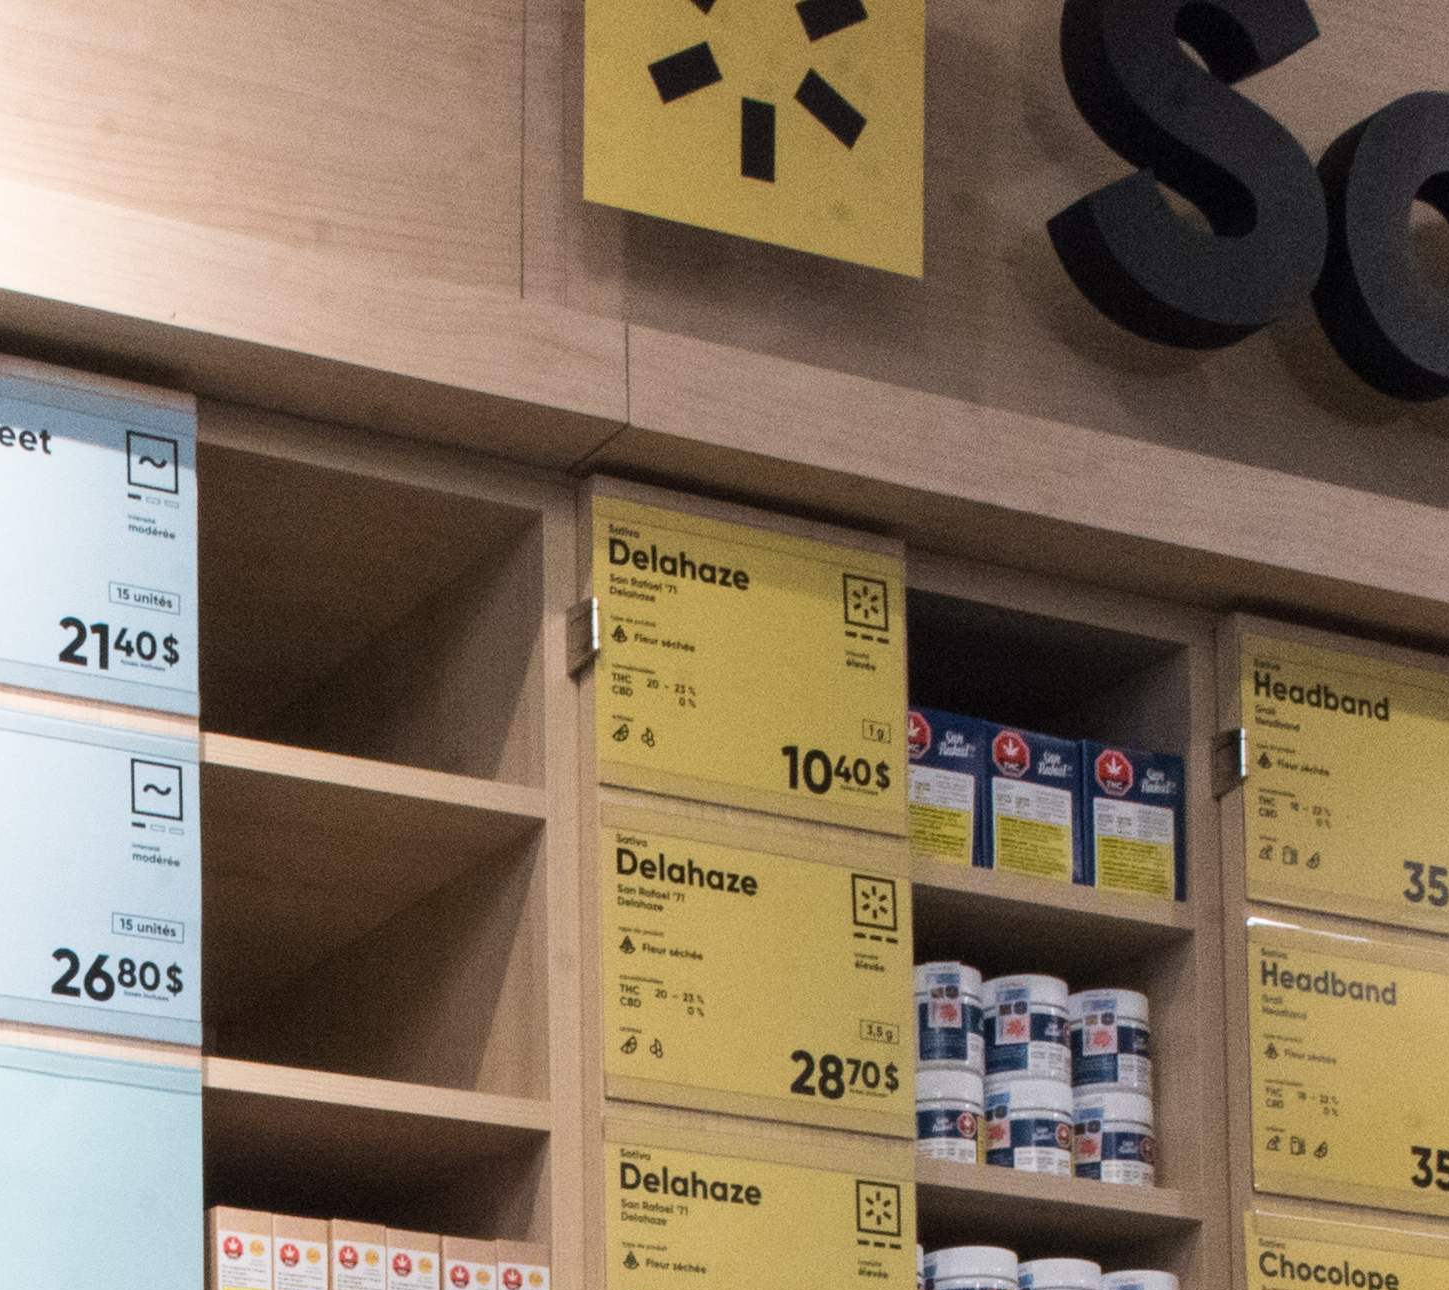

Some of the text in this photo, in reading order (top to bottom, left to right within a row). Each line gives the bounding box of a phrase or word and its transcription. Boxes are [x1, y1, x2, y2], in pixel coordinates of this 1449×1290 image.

[608, 539, 750, 591] Delahaze
[117, 587, 173, 609] 15 unités
[1254, 671, 1389, 722] Headband
[616, 848, 758, 896] Delahaze
[120, 918, 176, 938] 15 unités
[1261, 961, 1396, 1006] Headband
[620, 1162, 762, 1206] Delahaze
